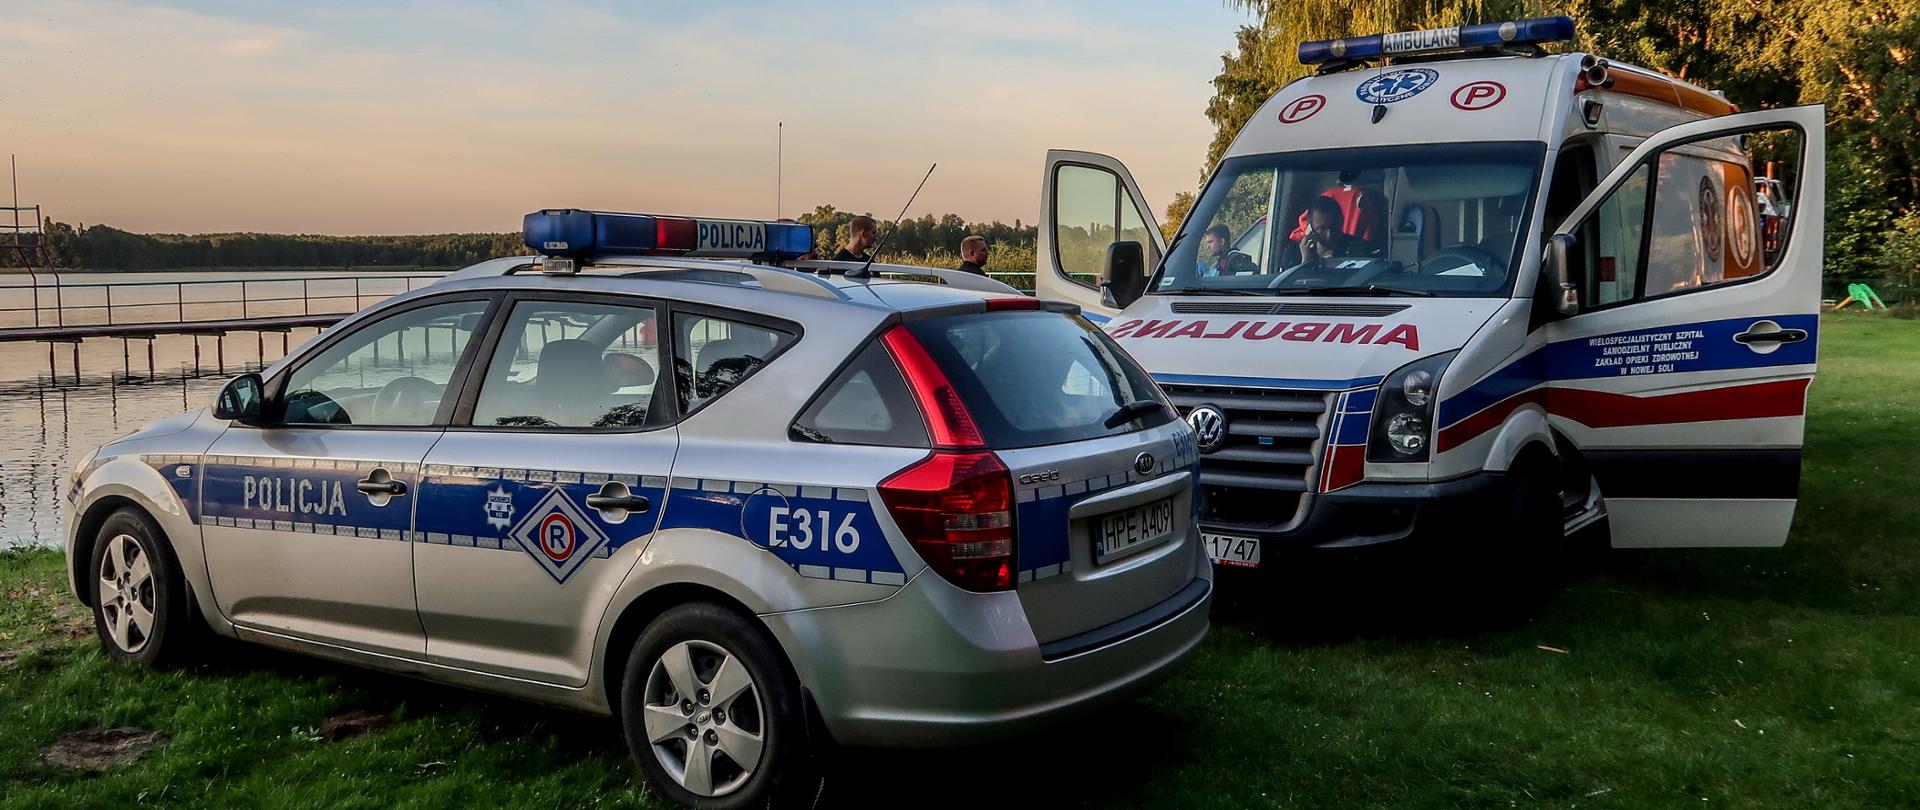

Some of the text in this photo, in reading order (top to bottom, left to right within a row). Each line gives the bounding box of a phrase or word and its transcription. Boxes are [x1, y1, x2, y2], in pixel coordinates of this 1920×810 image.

[1384, 29, 1458, 51] AMBULANS
[1463, 86, 1485, 105] P
[1289, 99, 1310, 118] P
[700, 223, 764, 249] POLICJA
[1589, 330, 1705, 346] WIELOSPECJALISTYCZNY SZPITAL
[1603, 341, 1692, 355] SAMODZIELNY PUBLICZNY
[1595, 351, 1699, 367] ZAKŁAD OPIEKI ZDROWOTNEJ
[1620, 364, 1674, 375] W NOWEJ SOLI
[243, 475, 347, 517] POLICJA
[550, 524, 567, 550] R
[768, 506, 860, 554] E316
[1104, 511, 1137, 551] HPE
